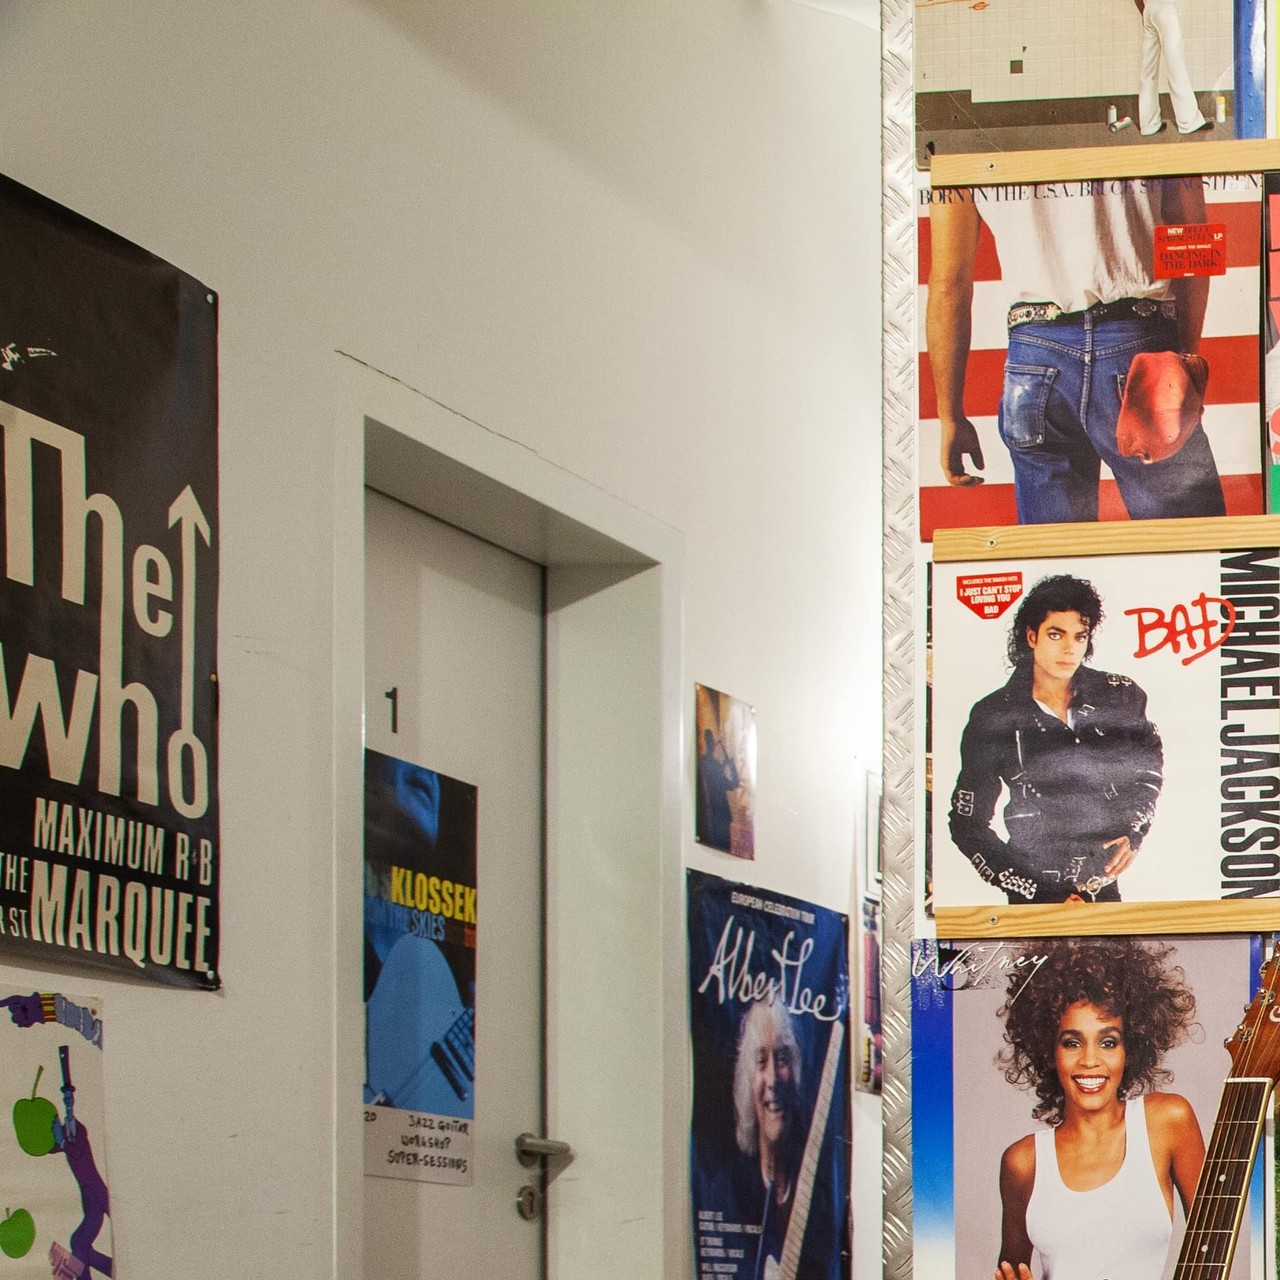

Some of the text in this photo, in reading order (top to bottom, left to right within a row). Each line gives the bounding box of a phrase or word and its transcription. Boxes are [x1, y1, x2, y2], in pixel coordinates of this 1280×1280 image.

[919, 184, 1029, 205] BORN THE
[1167, 227, 1184, 236] NEW
[964, 587, 981, 597] JUST
[971, 593, 1011, 604] LOVING YOU
[984, 605, 999, 614] BAD
[1124, 591, 1237, 667] BAD
[385, 686, 399, 733] 1
[1219, 549, 1280, 899] MICHAEL JACKSON
[34, 797, 165, 875] MAXIMUM
[31, 859, 212, 972] MARQUEE
[411, 909, 446, 941] SKIES
[698, 915, 800, 1007] Albert
[911, 940, 1050, 1003] Whitney
[408, 1115, 435, 1130] JAZZ
